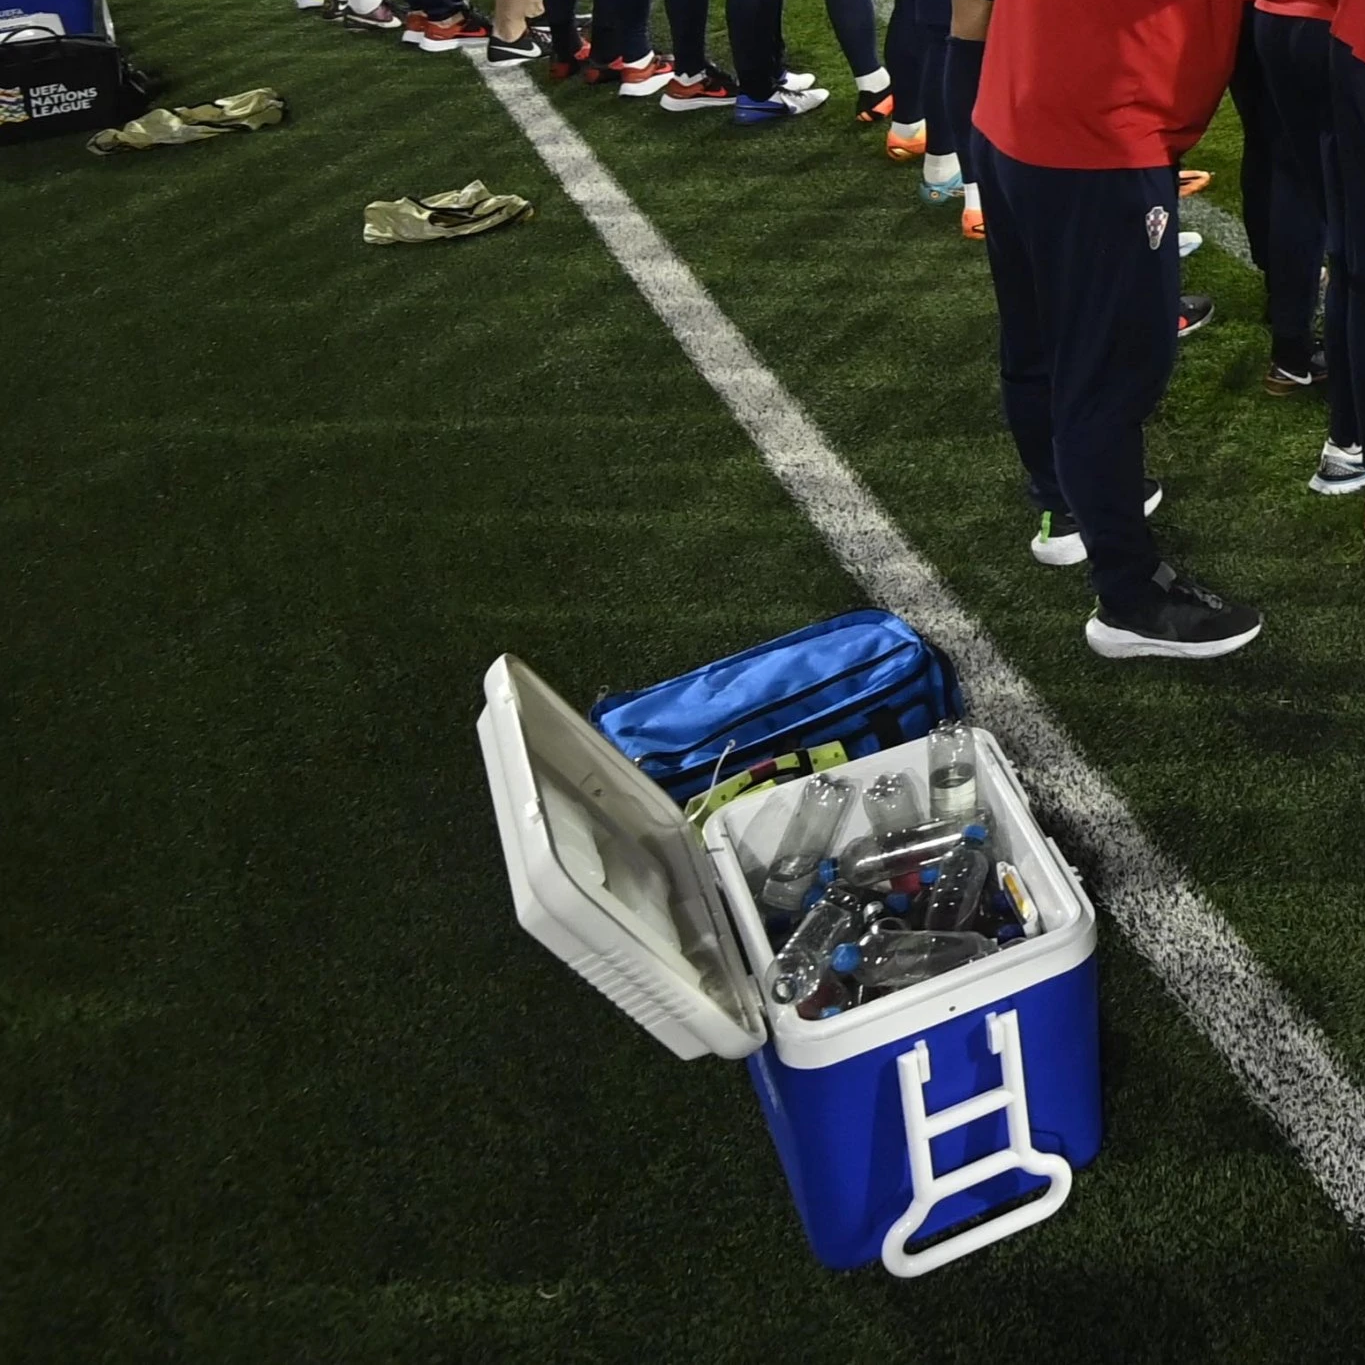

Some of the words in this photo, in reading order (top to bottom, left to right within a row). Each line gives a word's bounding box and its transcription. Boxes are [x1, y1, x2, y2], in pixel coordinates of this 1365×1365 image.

[29, 83, 68, 99] UEFA
[30, 87, 99, 108] NATIONS
[32, 99, 93, 120] LEAGUE
